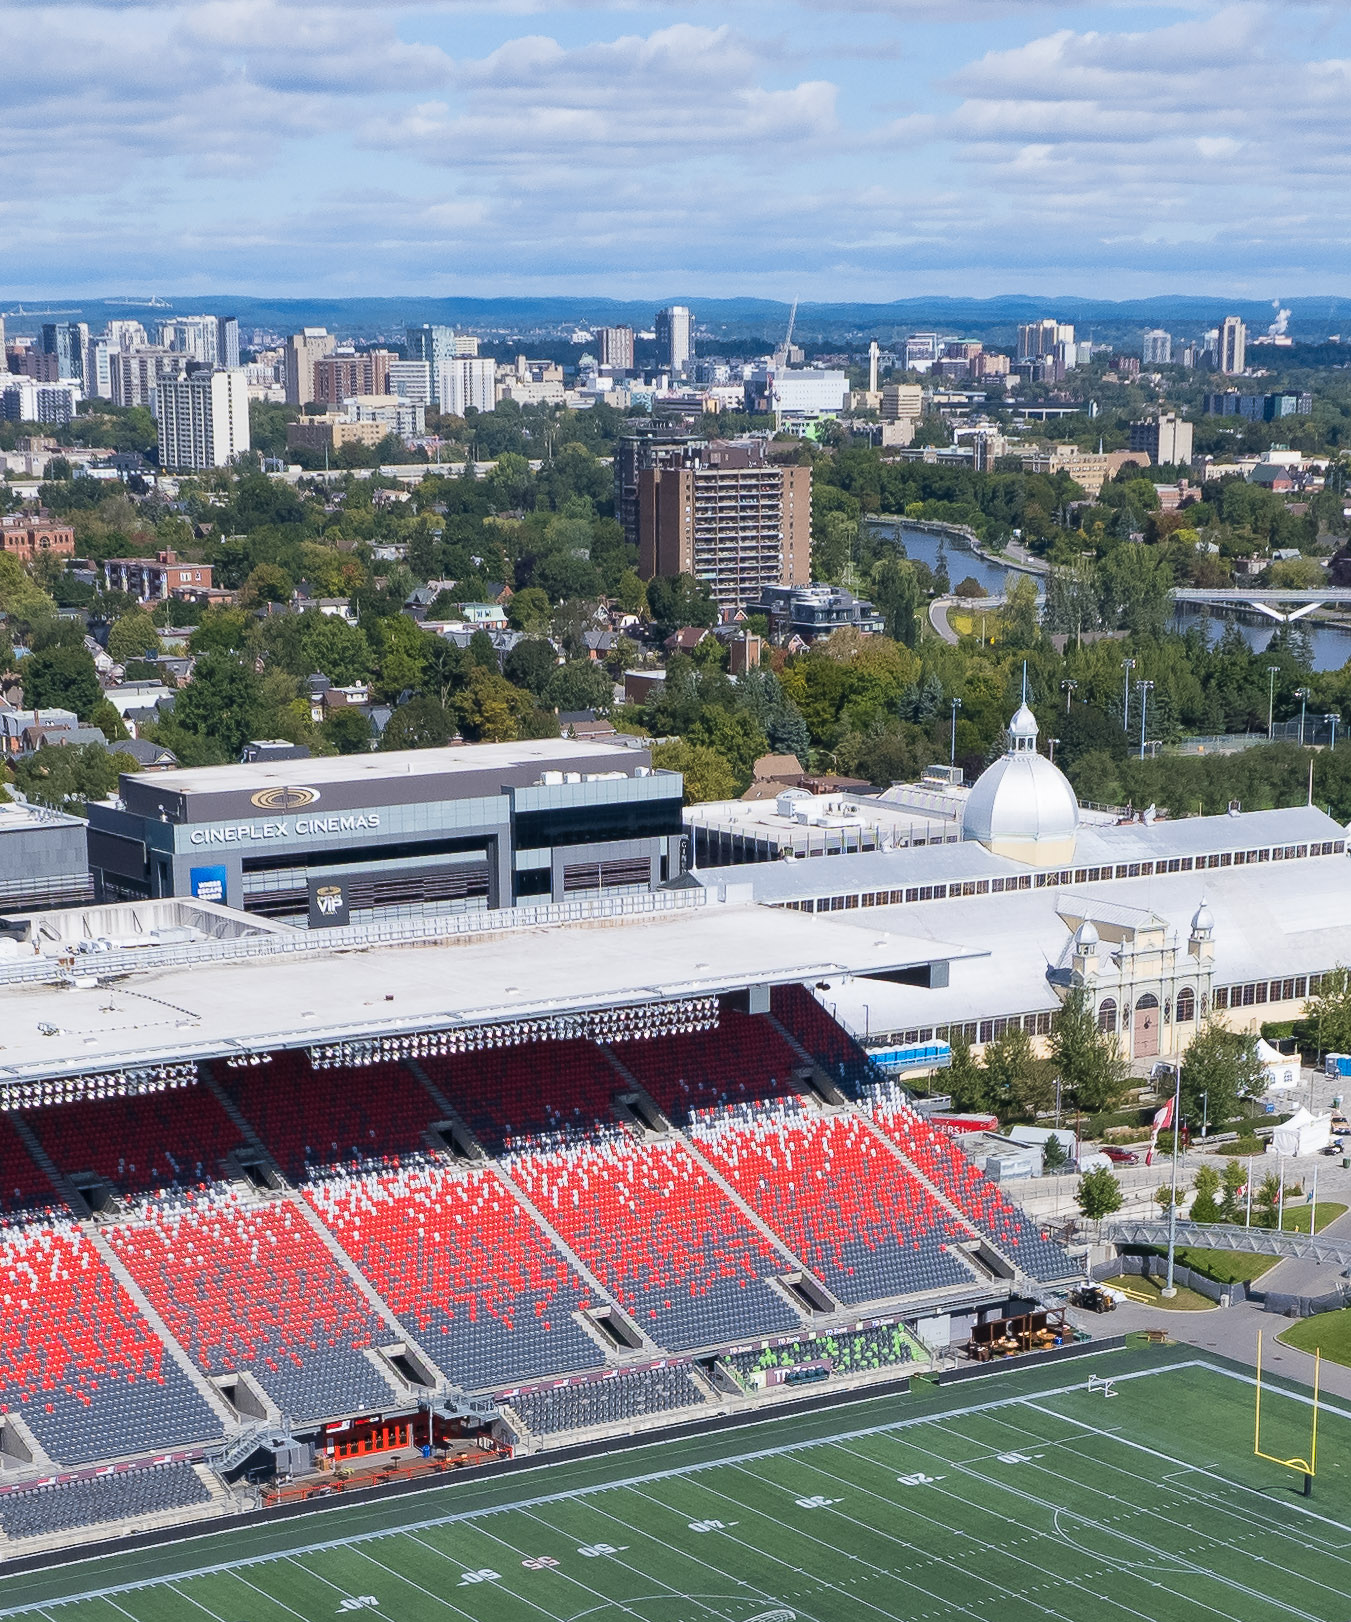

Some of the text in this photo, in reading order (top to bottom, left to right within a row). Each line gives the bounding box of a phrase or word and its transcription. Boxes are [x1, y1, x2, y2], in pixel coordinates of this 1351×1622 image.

[190, 814, 381, 844] CINEPLEX CINEMAS
[317, 897, 343, 913] VIP
[897, 1472, 934, 1486] 20
[794, 1496, 833, 1508] 30
[688, 1520, 726, 1532] 40
[577, 1543, 618, 1558] 50
[521, 1556, 560, 1570] 55
[460, 1568, 502, 1584] 50
[340, 1594, 380, 1610] 40
